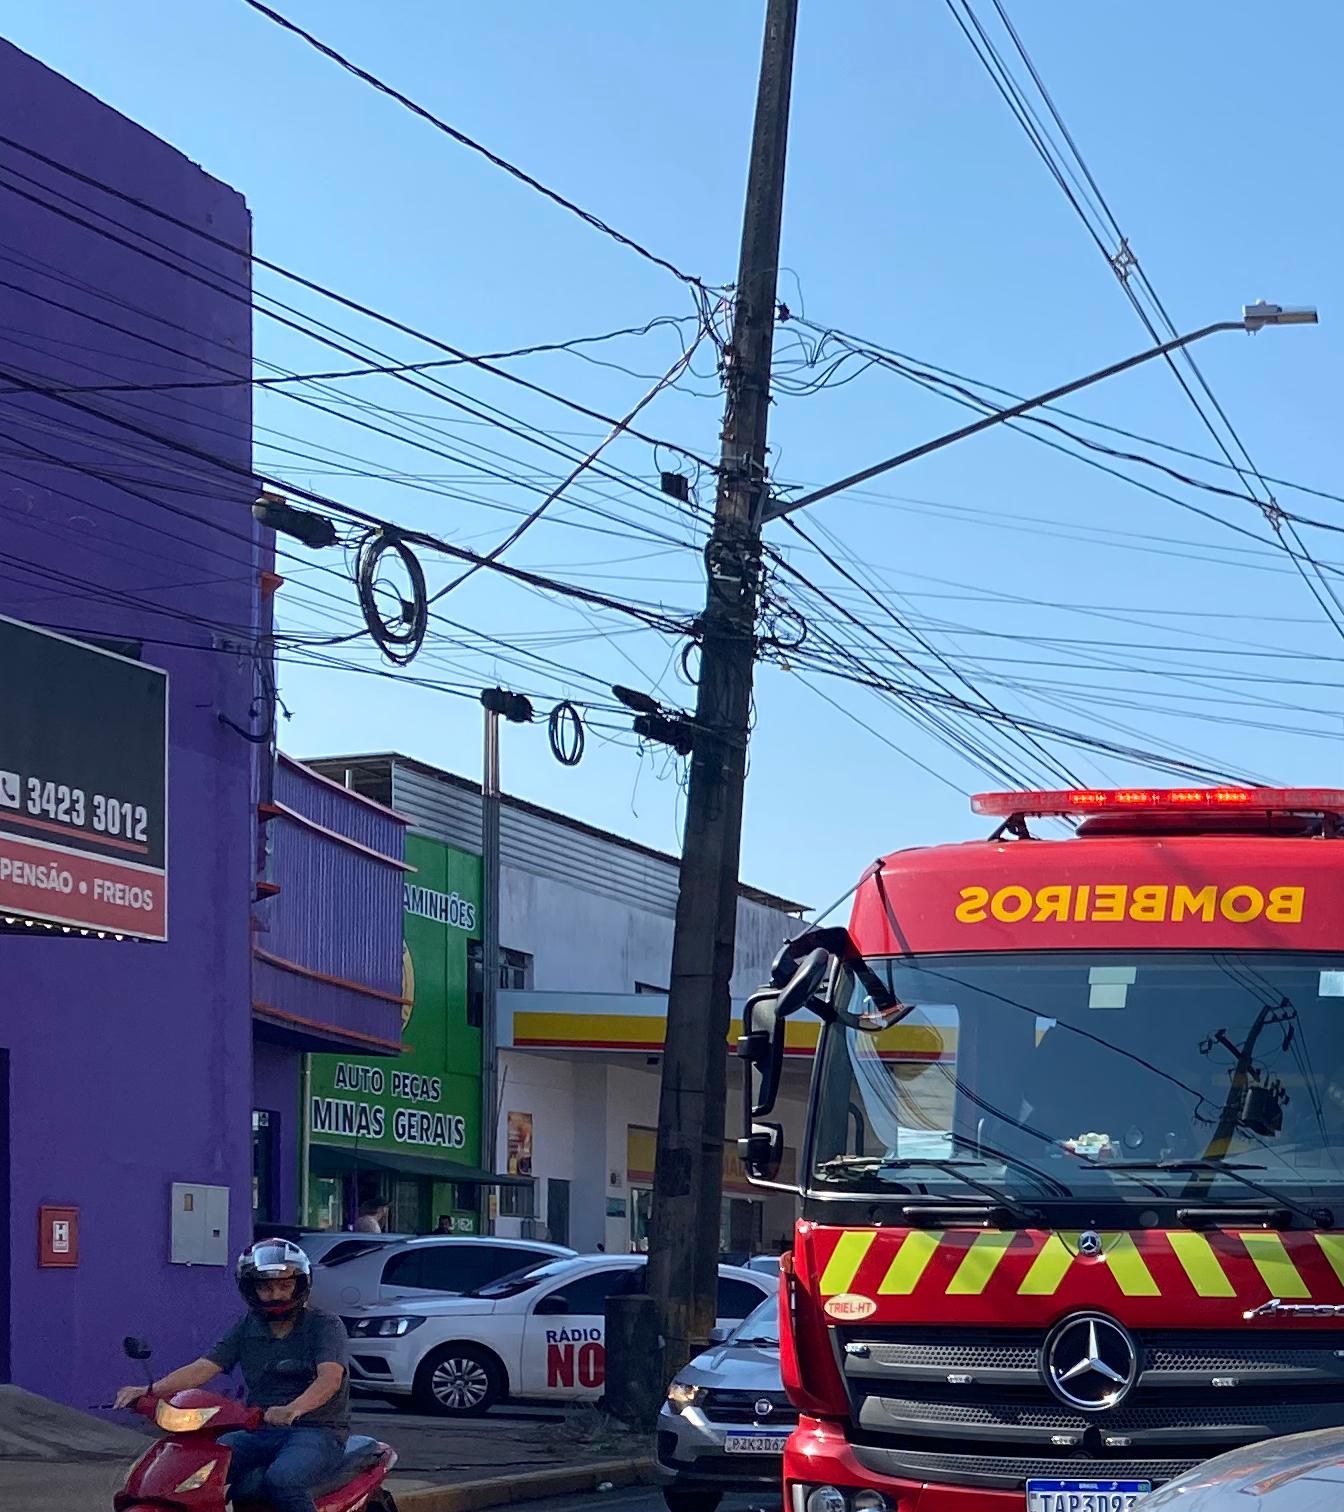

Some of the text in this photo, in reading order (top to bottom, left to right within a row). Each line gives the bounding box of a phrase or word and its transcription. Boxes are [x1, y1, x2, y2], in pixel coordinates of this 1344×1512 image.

[27, 777, 148, 842] 3423 3012
[0, 857, 154, 912] PENSÃO FREIOS
[334, 1062, 441, 1103] AUTO PEÇAS
[311, 1096, 466, 1149] MINAS GERAIS
[829, 1301, 872, 1314] TRIEL-HT
[546, 1326, 601, 1343] RÁDIO
